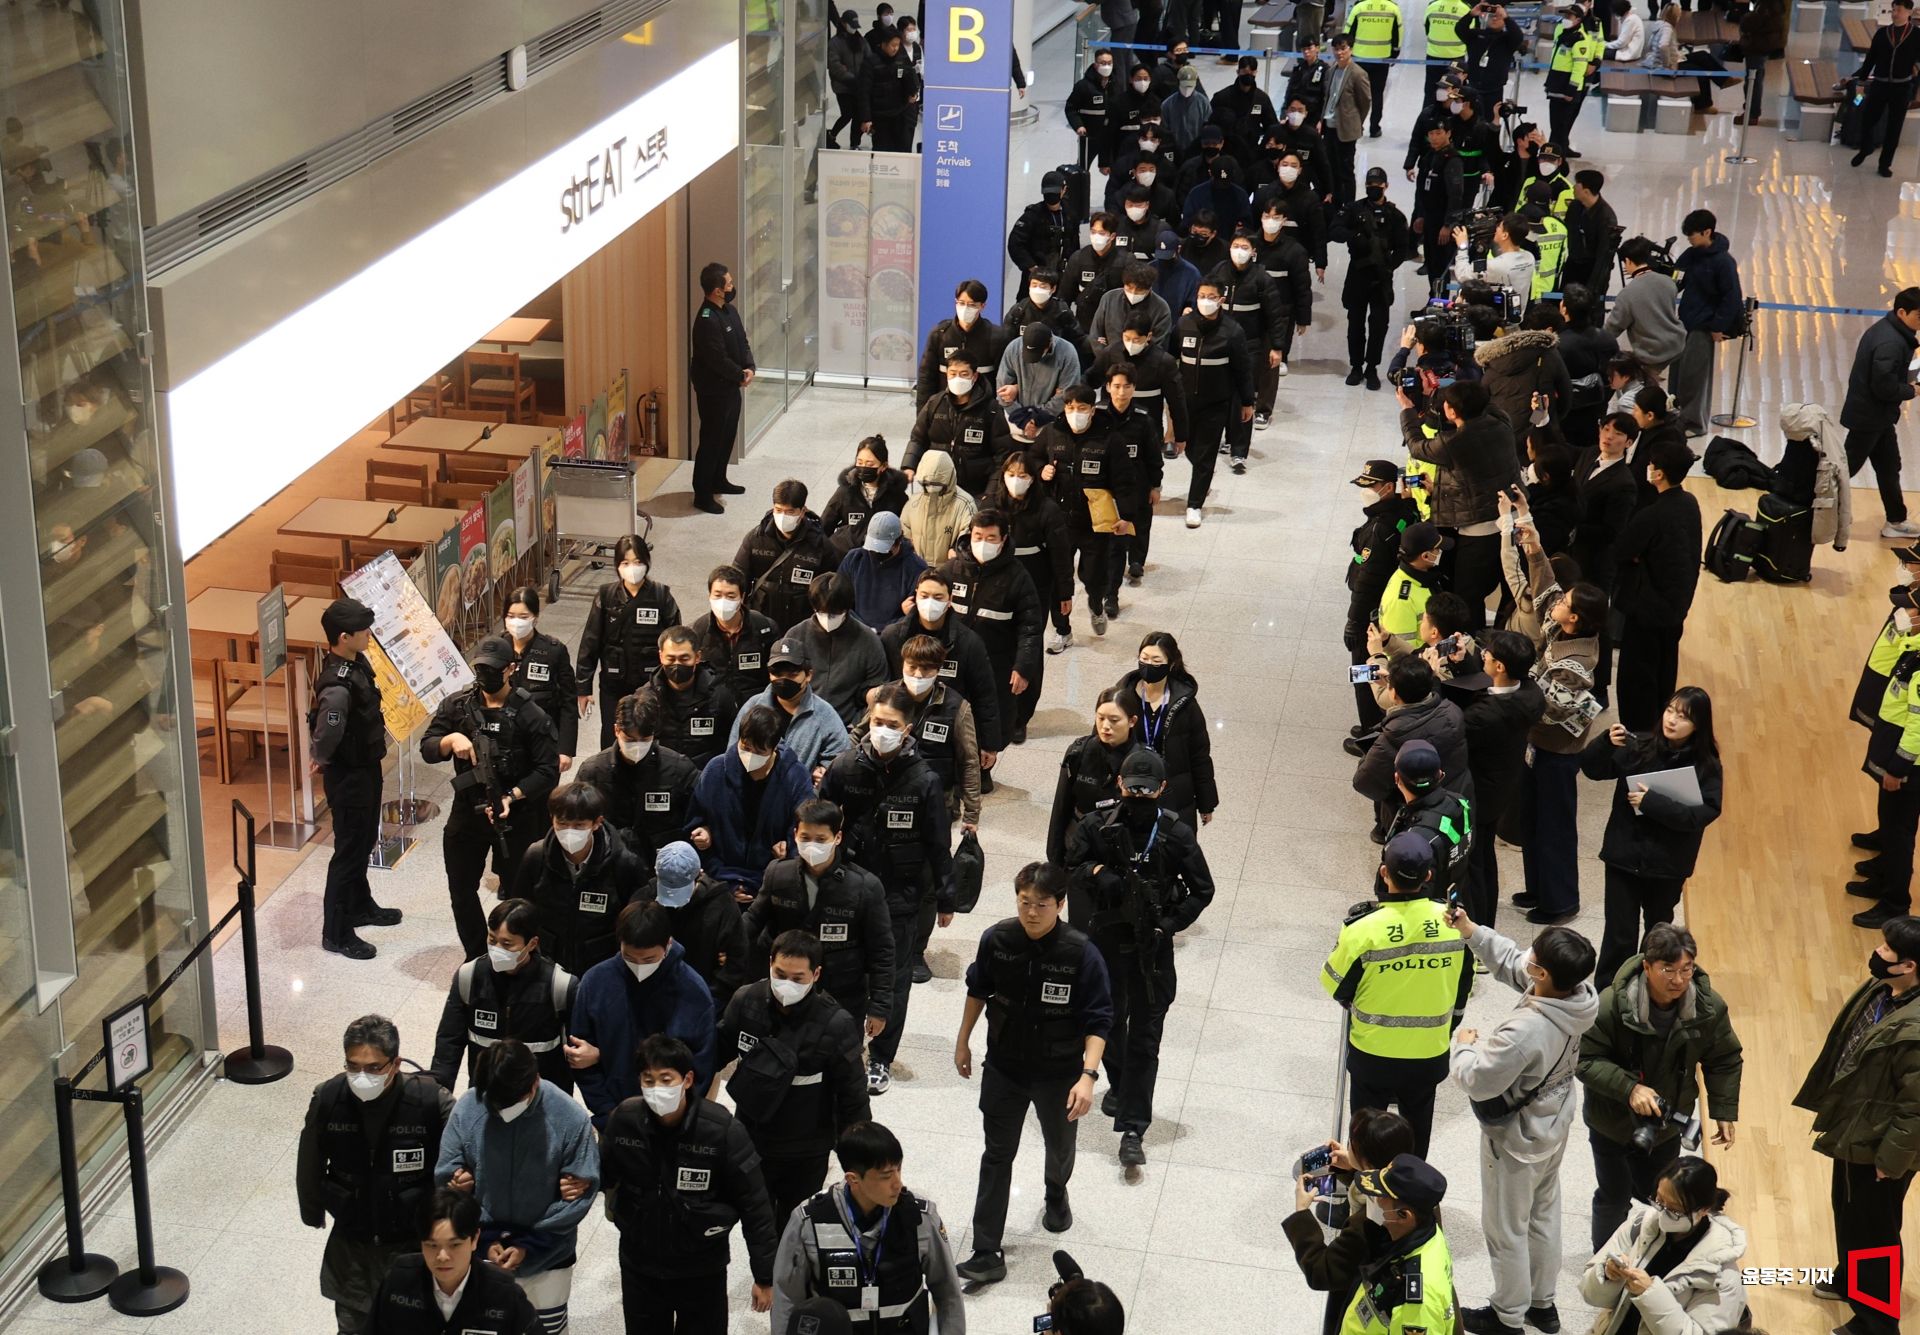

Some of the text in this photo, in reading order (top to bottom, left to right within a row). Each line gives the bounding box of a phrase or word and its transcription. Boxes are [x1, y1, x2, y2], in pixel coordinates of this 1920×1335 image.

[948, 7, 985, 63] B
[936, 140, 959, 154] 도착
[936, 156, 971, 167] Arrivals
[561, 125, 669, 234] strEAT 스트릿
[886, 795, 919, 804] POLICE
[891, 813, 910, 822] 형사
[1040, 963, 1077, 974] POLICE
[1378, 957, 1452, 973] POLICE
[678, 1143, 718, 1156] POLICE
[397, 1152, 421, 1163] 형사
[682, 1170, 707, 1182] 형사
